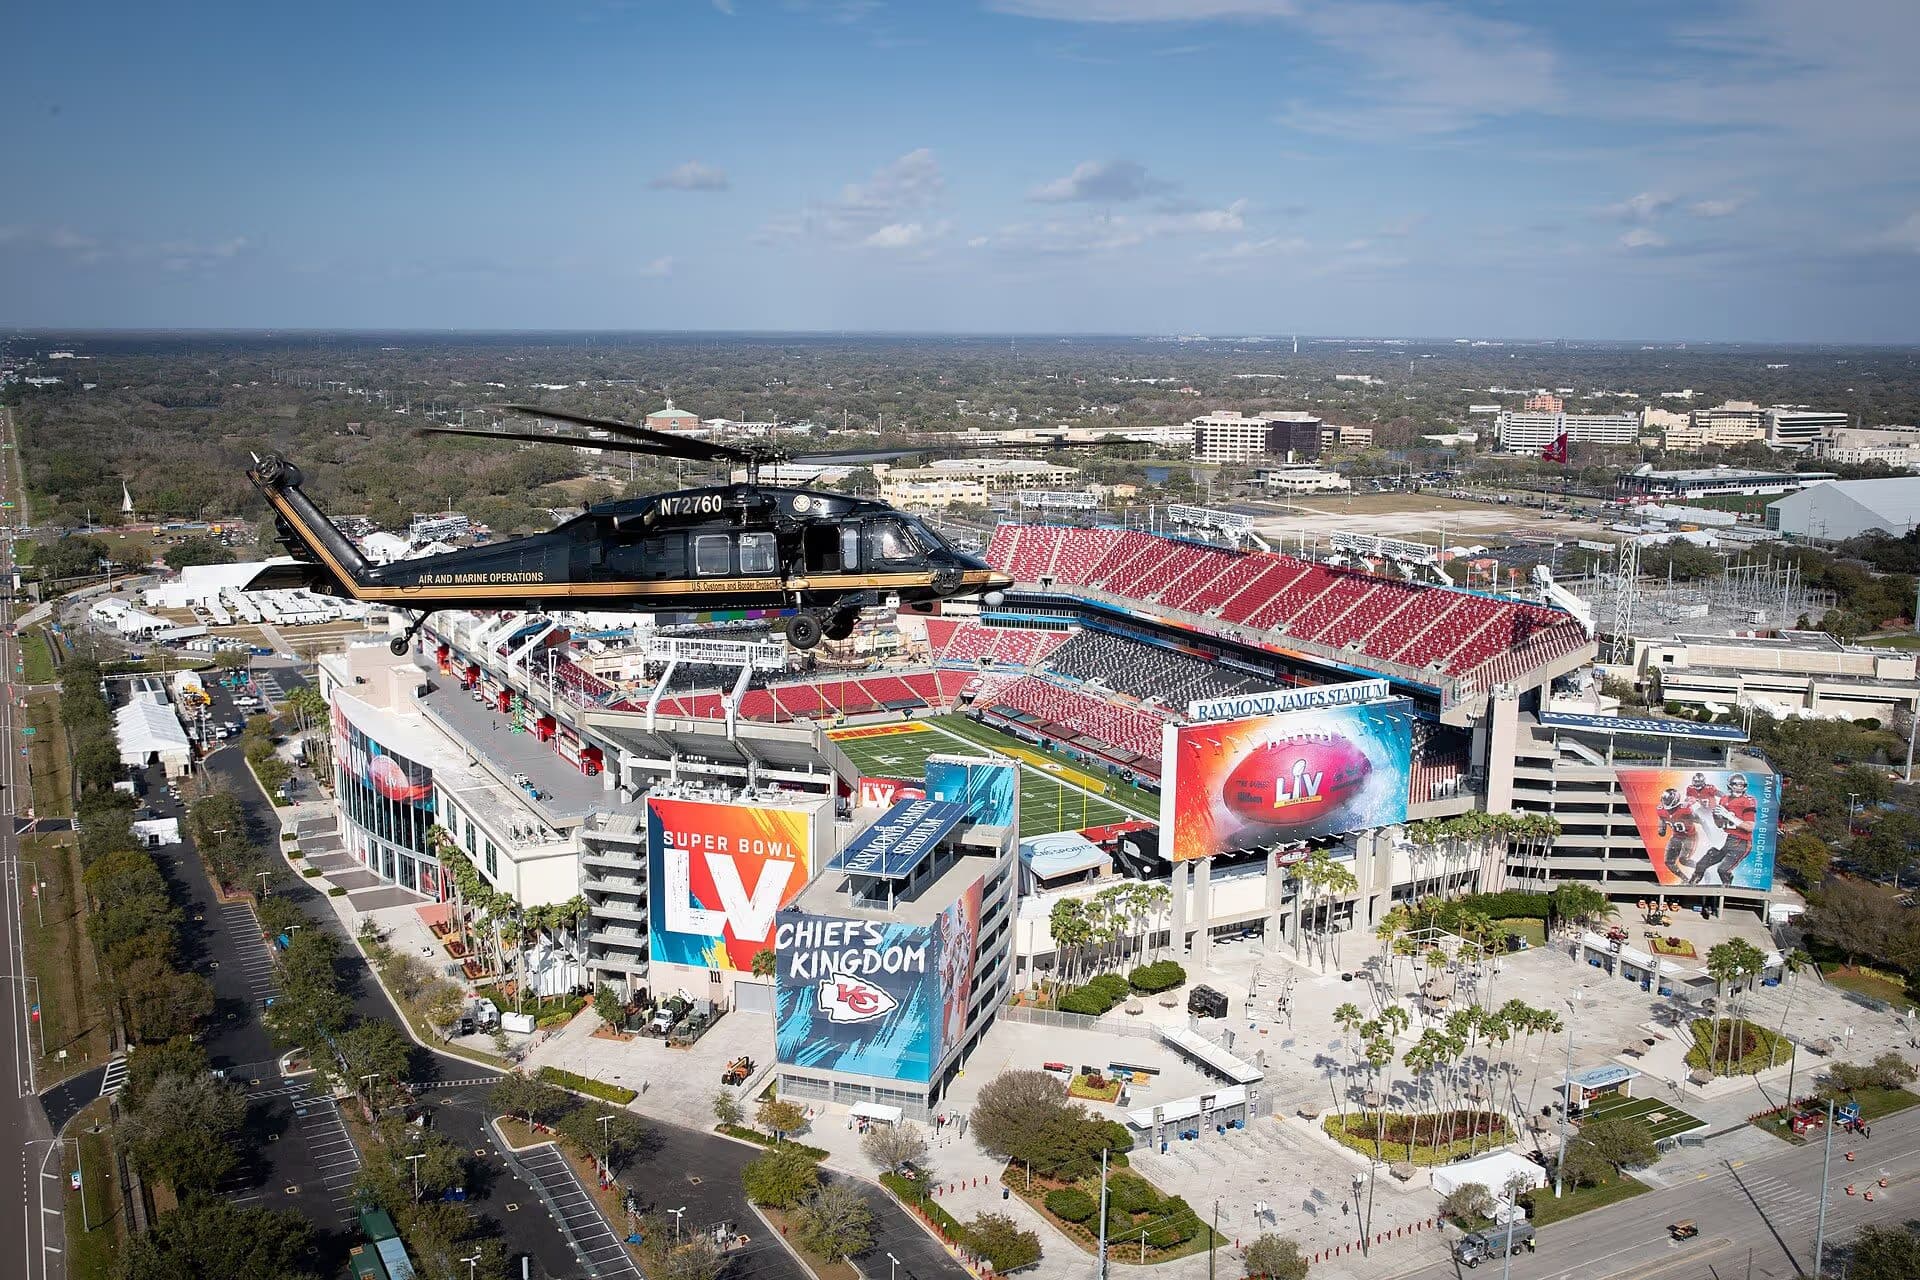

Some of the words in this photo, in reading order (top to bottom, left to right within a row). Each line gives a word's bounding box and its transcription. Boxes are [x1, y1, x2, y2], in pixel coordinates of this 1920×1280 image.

[661, 494, 722, 516] N72760
[418, 574, 433, 584] AIR
[434, 573, 452, 584] AND
[454, 573, 487, 583] MARINE
[489, 571, 544, 583] OPERATIONS
[704, 582, 726, 591] Customs
[1198, 697, 1275, 720] RAYMOND
[1275, 691, 1325, 711] JAMES
[1328, 682, 1388, 702] STADIUM
[1543, 712, 1660, 727] RAYMOND
[1662, 722, 1739, 732] JAMES
[1591, 721, 1691, 734] STADIUM
[1763, 775, 1773, 804] TAMPA
[1760, 806, 1769, 825] BAY
[663, 831, 728, 851] SUPER
[738, 838, 796, 858] BOWL
[845, 825, 906, 870] RAYMOND
[901, 800, 935, 826] JAMES
[893, 818, 945, 855] STADIUM
[1752, 827, 1767, 885] BUCCANEERS
[663, 847, 796, 943] LV
[776, 920, 884, 950] CHIEFS
[790, 946, 926, 979] KINGDOM
[836, 983, 879, 1014] KC
